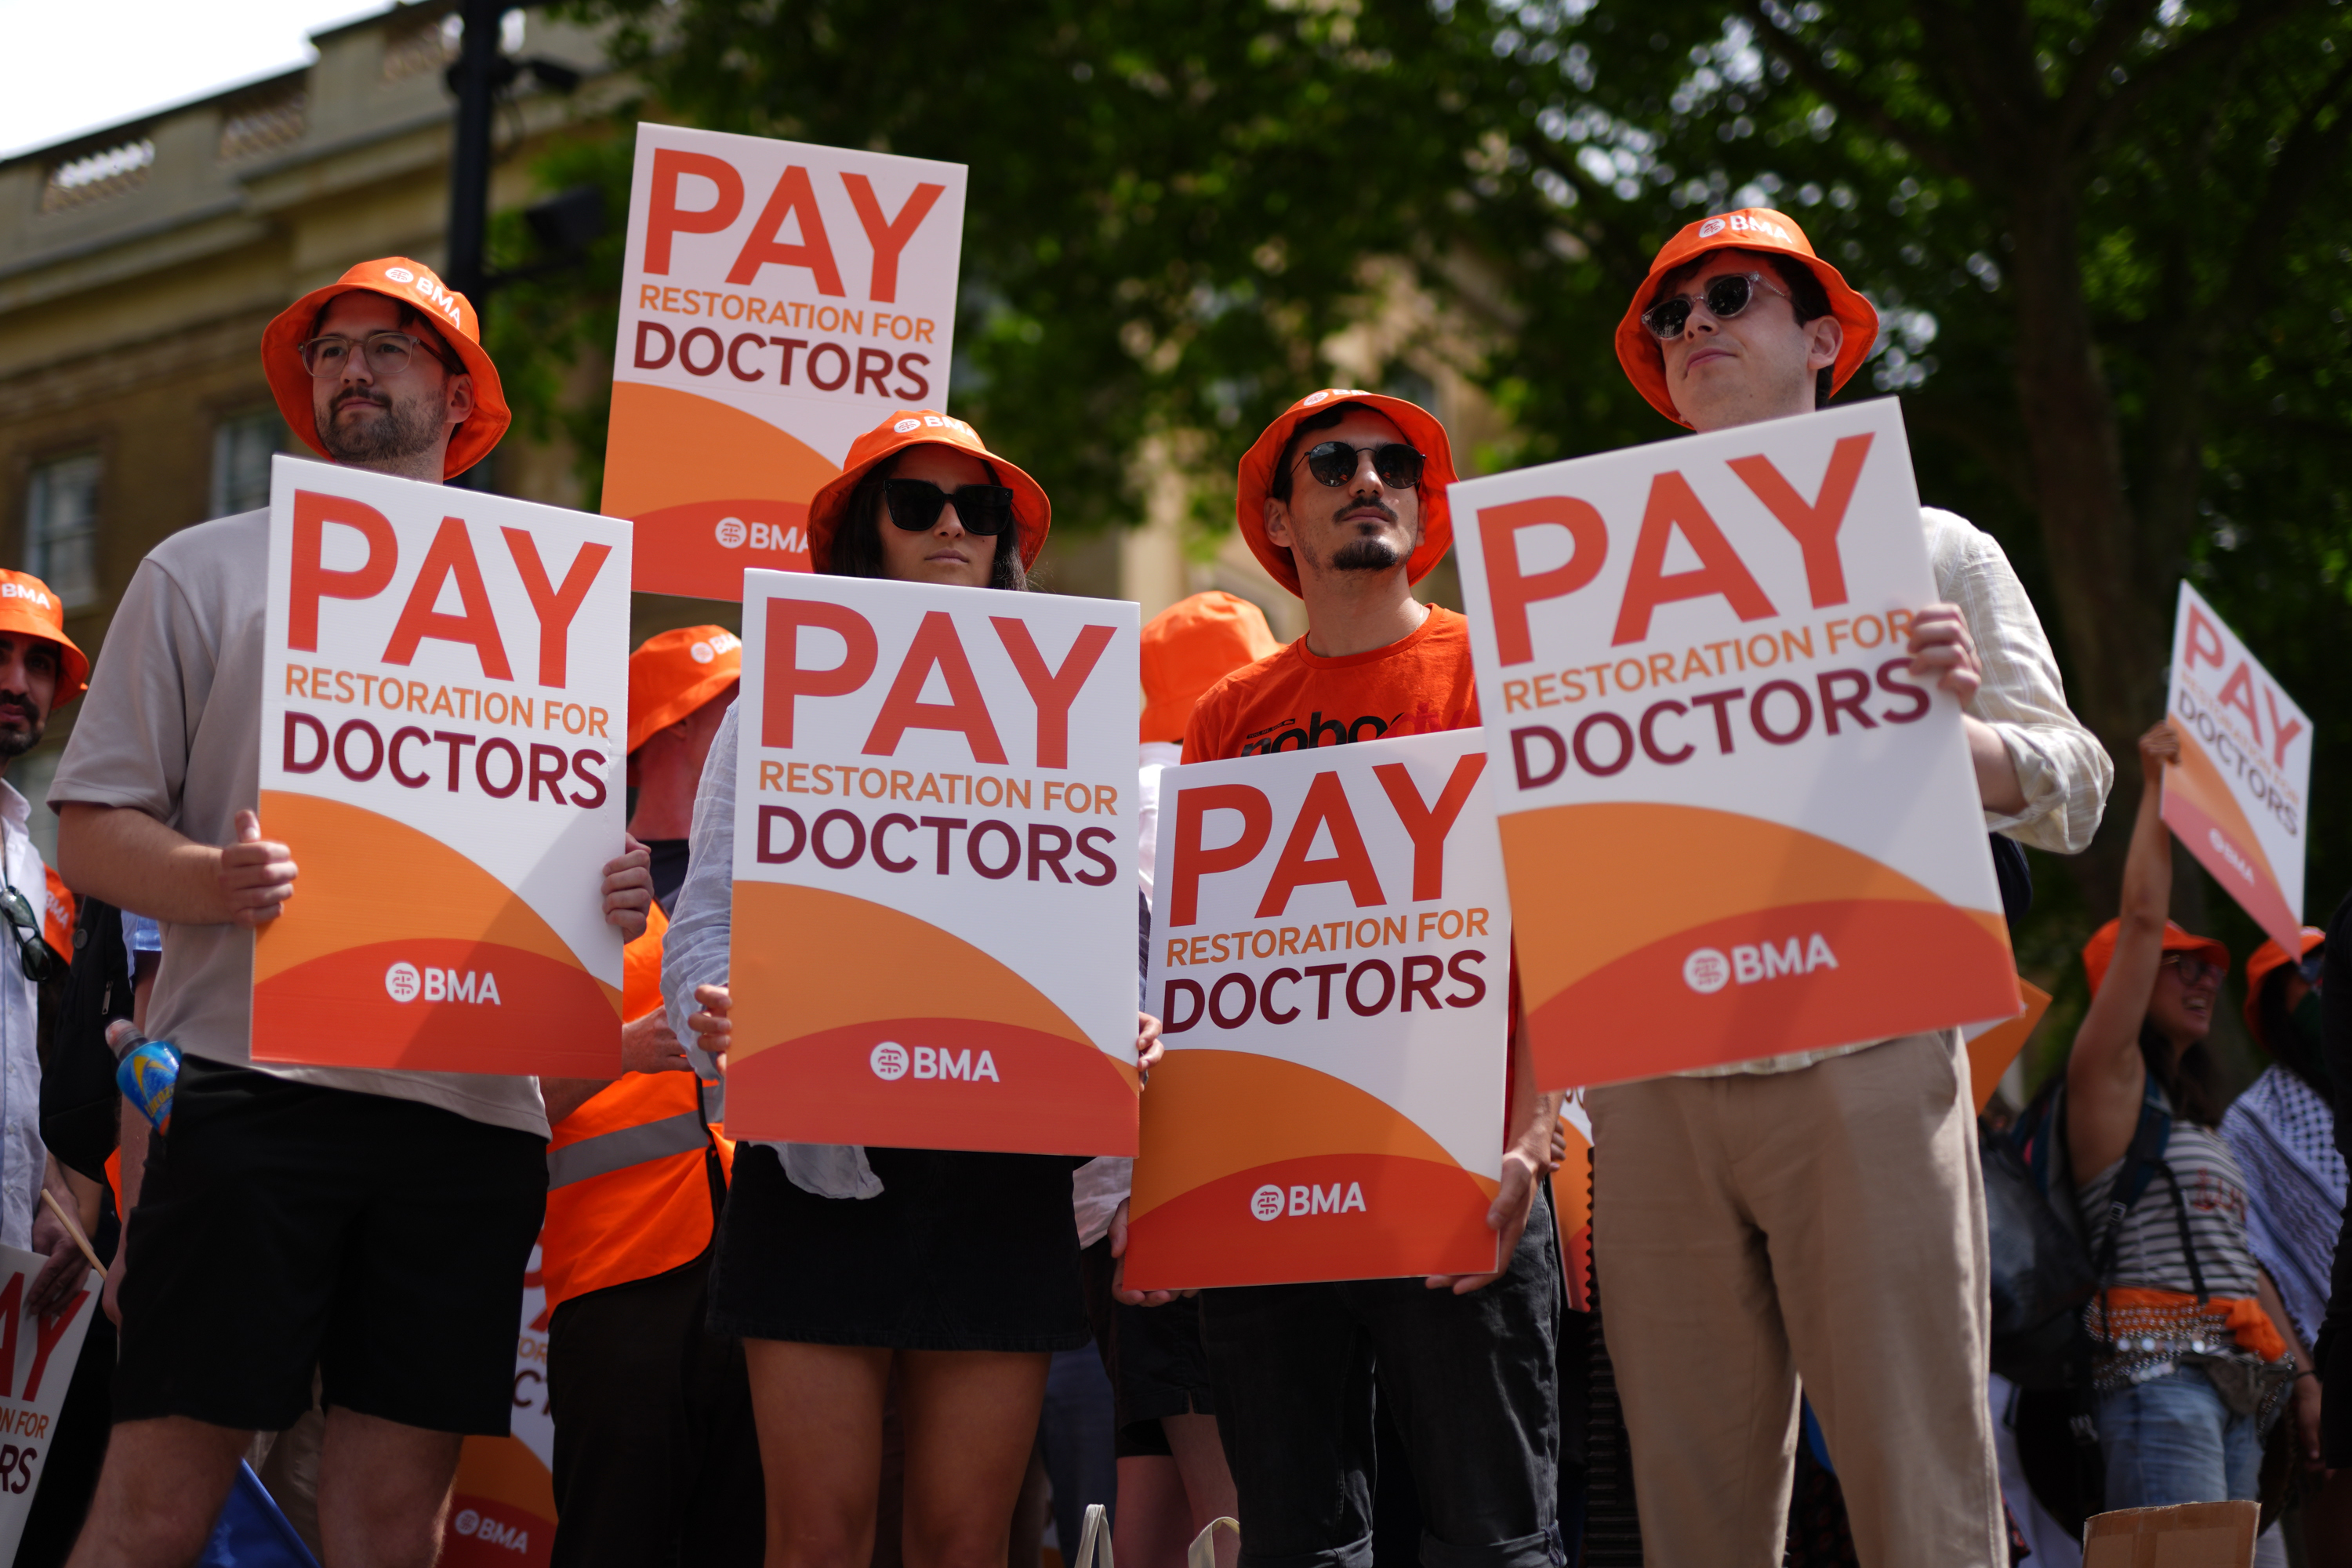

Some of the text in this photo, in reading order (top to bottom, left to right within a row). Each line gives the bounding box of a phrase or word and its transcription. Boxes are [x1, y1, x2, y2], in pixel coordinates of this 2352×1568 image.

[643, 147, 946, 303] PAY
[1730, 215, 1793, 245] BMA
[416, 276, 460, 329] BMA
[638, 284, 936, 343] RESTORATION FOR
[633, 319, 932, 401] DOCTORS
[924, 416, 981, 445] BMA
[1477, 431, 1875, 667] PAY
[2, 583, 51, 610] BMA
[288, 489, 612, 689] PAY
[709, 633, 742, 655] BM
[1502, 608, 1914, 713] RESTORATION FOR
[285, 664, 609, 738] RESTORATION FOR
[761, 597, 1118, 770] PAY
[2183, 602, 2303, 770] PAY
[283, 710, 607, 808] DOCTORS
[1510, 657, 1931, 790] DOCTORS
[759, 760, 1118, 815] RESTORATION FOR
[2179, 688, 2298, 837] DOCTORS
[757, 804, 1117, 887] DOCTORS
[1170, 753, 1486, 927] PAY
[1166, 907, 1490, 967] RESTORATION FOR
[1732, 933, 1838, 986] BMA
[424, 969, 501, 1005] BMA
[1162, 949, 1487, 1035] DOCTORS
[914, 1047, 1000, 1082] BMA
[1288, 1181, 1367, 1216] BMA
[0, 1271, 91, 1403] AY
[16, 1411, 49, 1439] FOR
[477, 1518, 529, 1553] BMA
